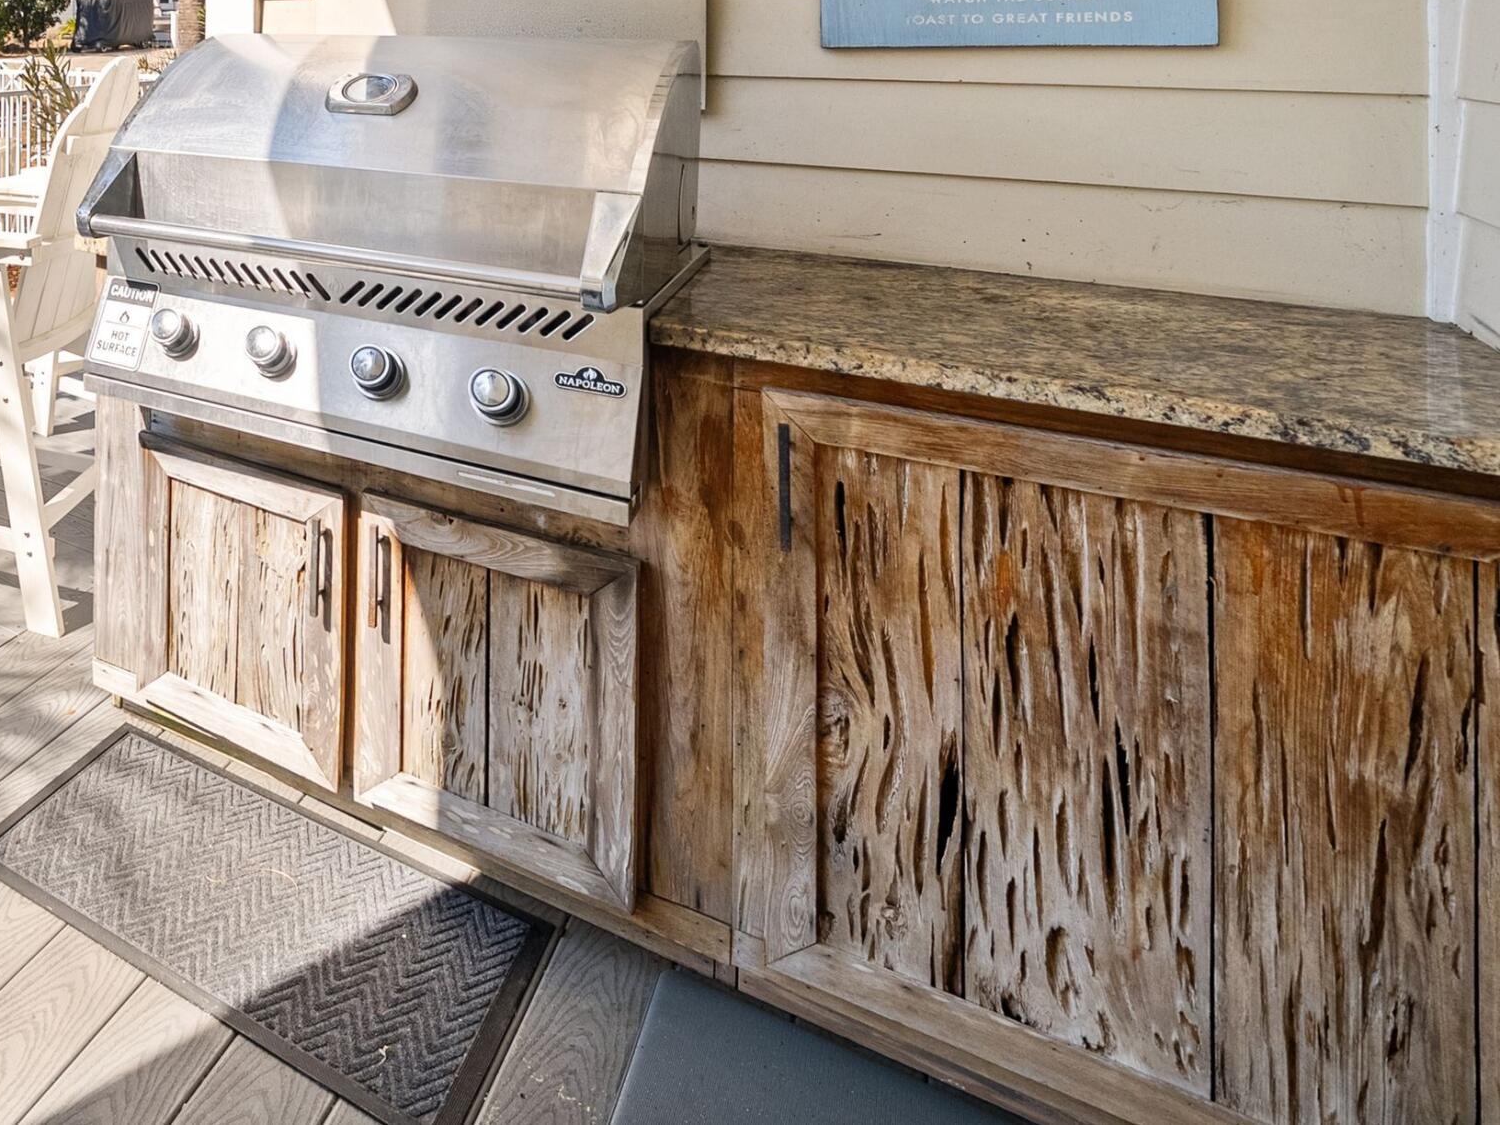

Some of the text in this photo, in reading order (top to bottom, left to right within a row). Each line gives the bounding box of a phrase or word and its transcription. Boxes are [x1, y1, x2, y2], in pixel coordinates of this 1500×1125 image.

[962, 13, 984, 25] TO
[991, 12, 1048, 25] GREAT
[1055, 10, 1133, 24] FRIENDS
[110, 284, 156, 303] CAUTION
[110, 330, 130, 342] HOT
[96, 339, 138, 357] SURFACE
[558, 375, 621, 394] NAPOLEON
